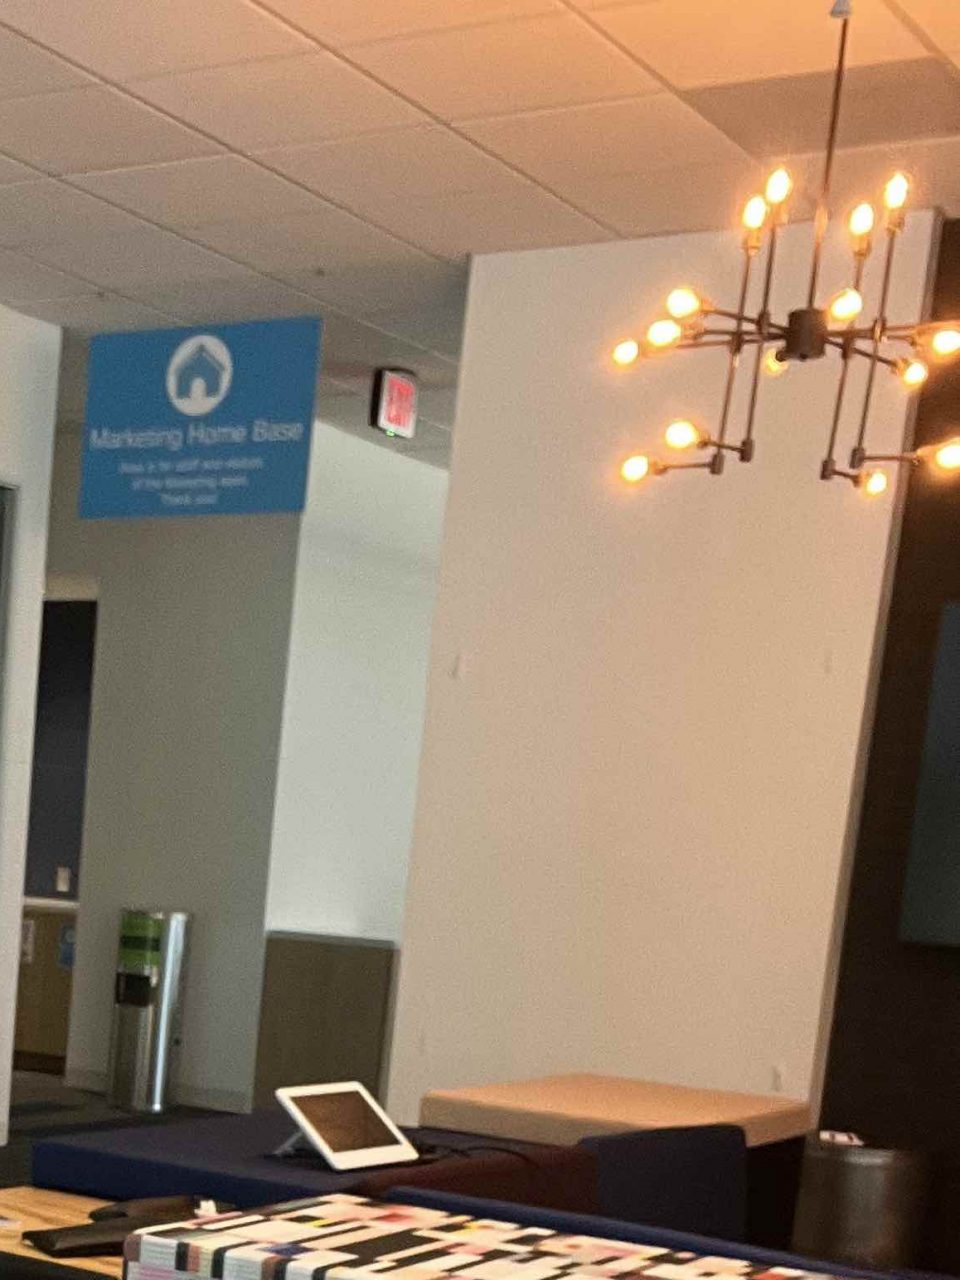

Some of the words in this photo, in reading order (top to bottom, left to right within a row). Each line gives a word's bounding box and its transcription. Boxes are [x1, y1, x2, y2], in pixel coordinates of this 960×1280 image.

[91, 427, 183, 451] Marketing
[187, 423, 247, 444] Home
[252, 419, 304, 442] Base
